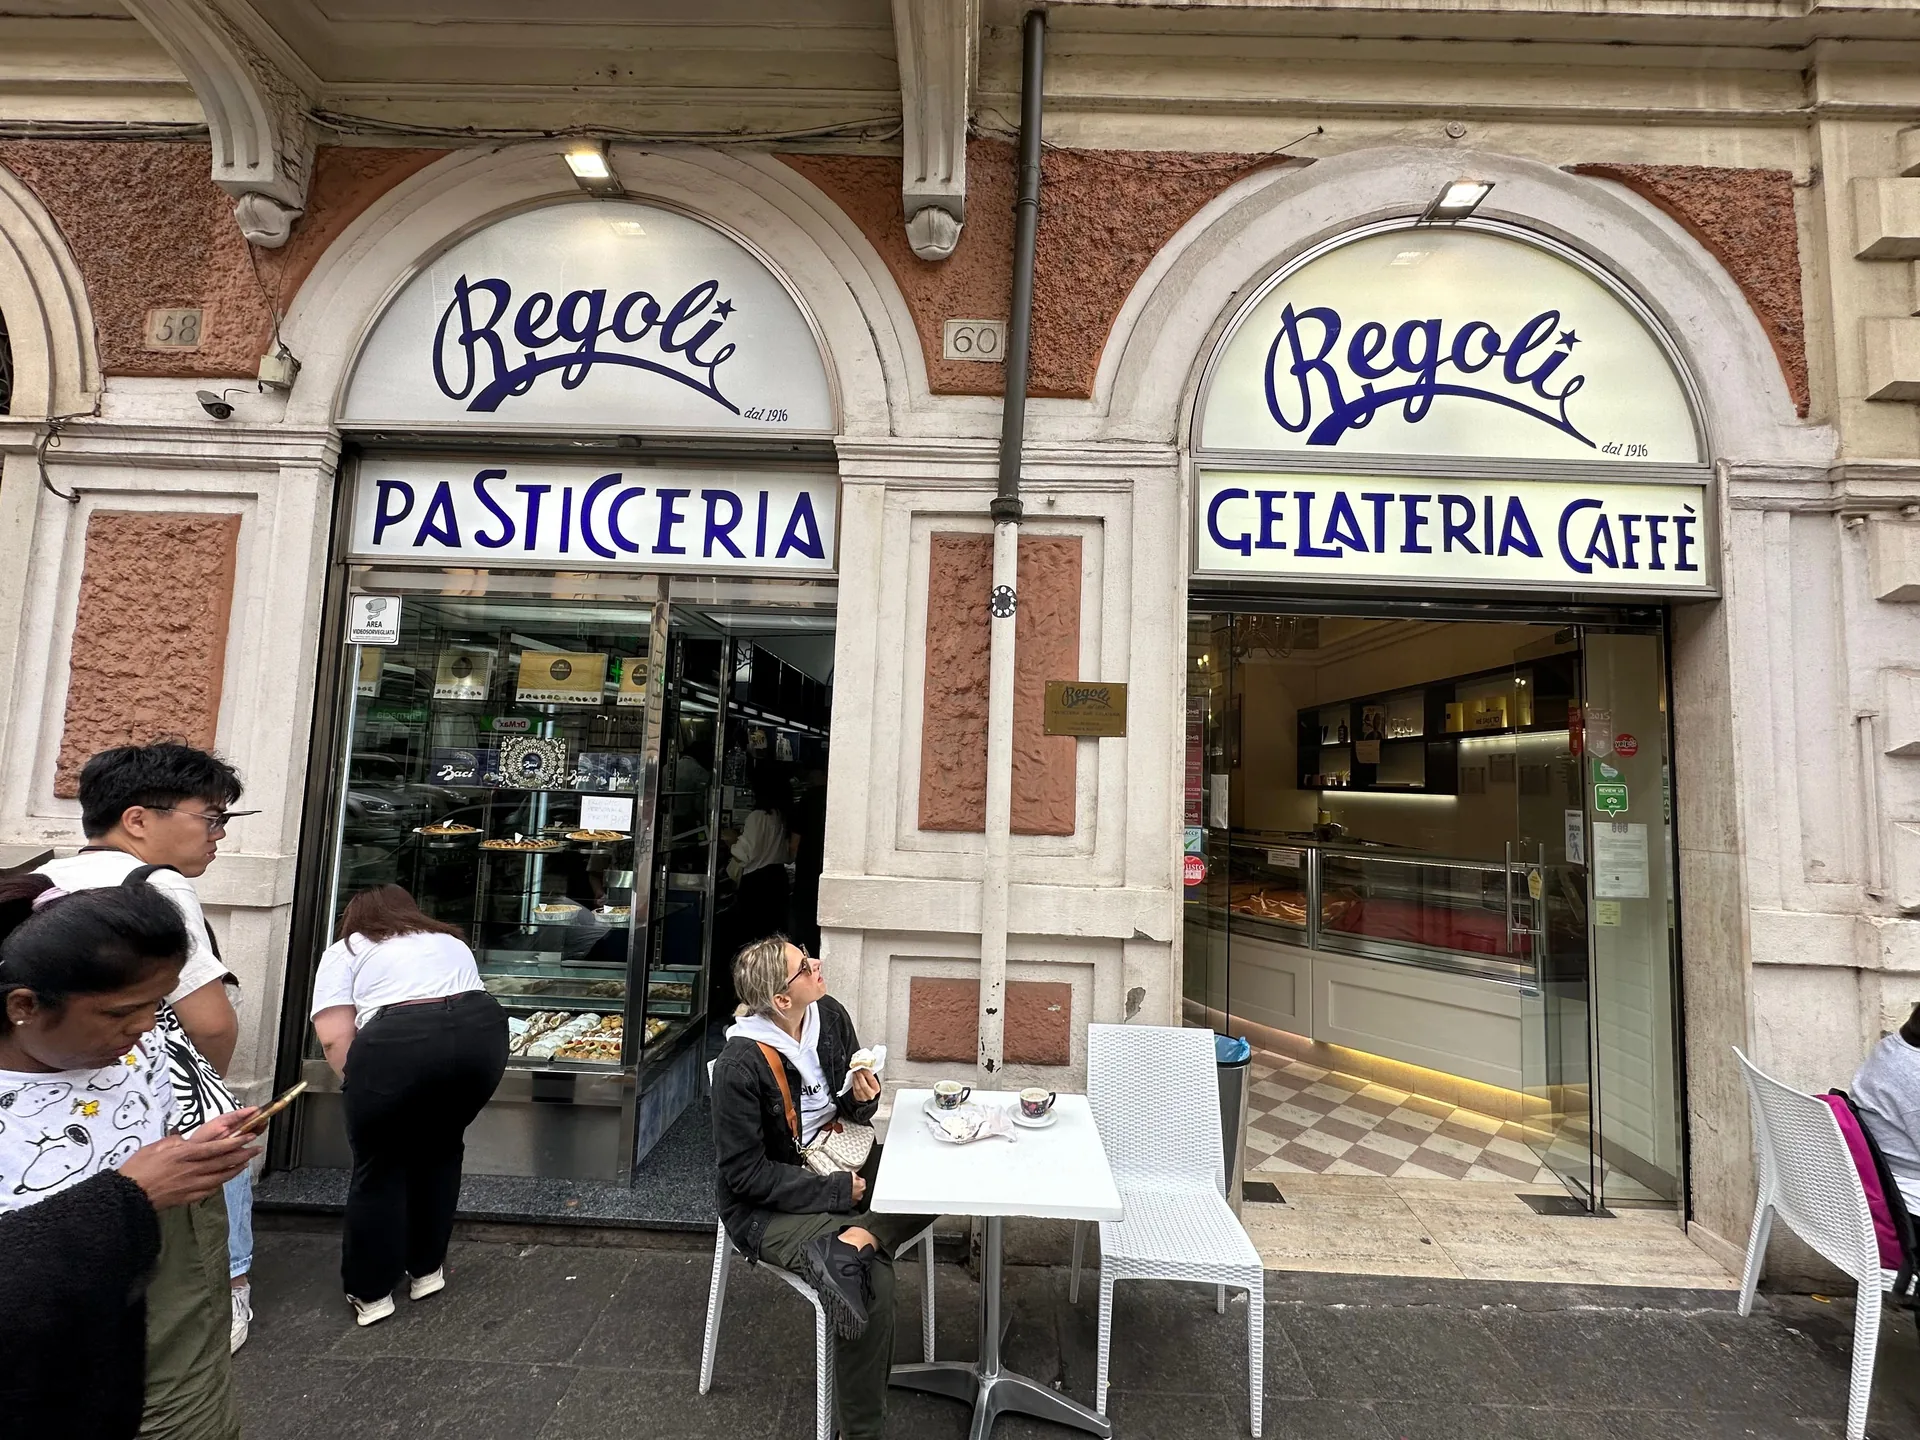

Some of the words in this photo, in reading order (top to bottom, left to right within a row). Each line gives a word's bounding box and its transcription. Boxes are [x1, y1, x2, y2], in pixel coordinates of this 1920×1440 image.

[156, 315, 196, 342] 58
[433, 273, 742, 415] Regoli
[953, 326, 997, 354] 60
[1264, 302, 1597, 449] Regoli
[744, 406, 765, 421] dal
[765, 409, 788, 422] 1916
[1601, 441, 1623, 456] dal
[1624, 443, 1648, 457] 1916
[372, 469, 825, 560] PASTICCERIA
[1207, 488, 1543, 559] GELATERIA
[1558, 499, 1698, 574] CAFFÈ
[1589, 712, 1611, 720] 2015
[436, 764, 475, 781] Baci
[566, 769, 591, 785] Baci
[1184, 863, 1205, 871] usto
